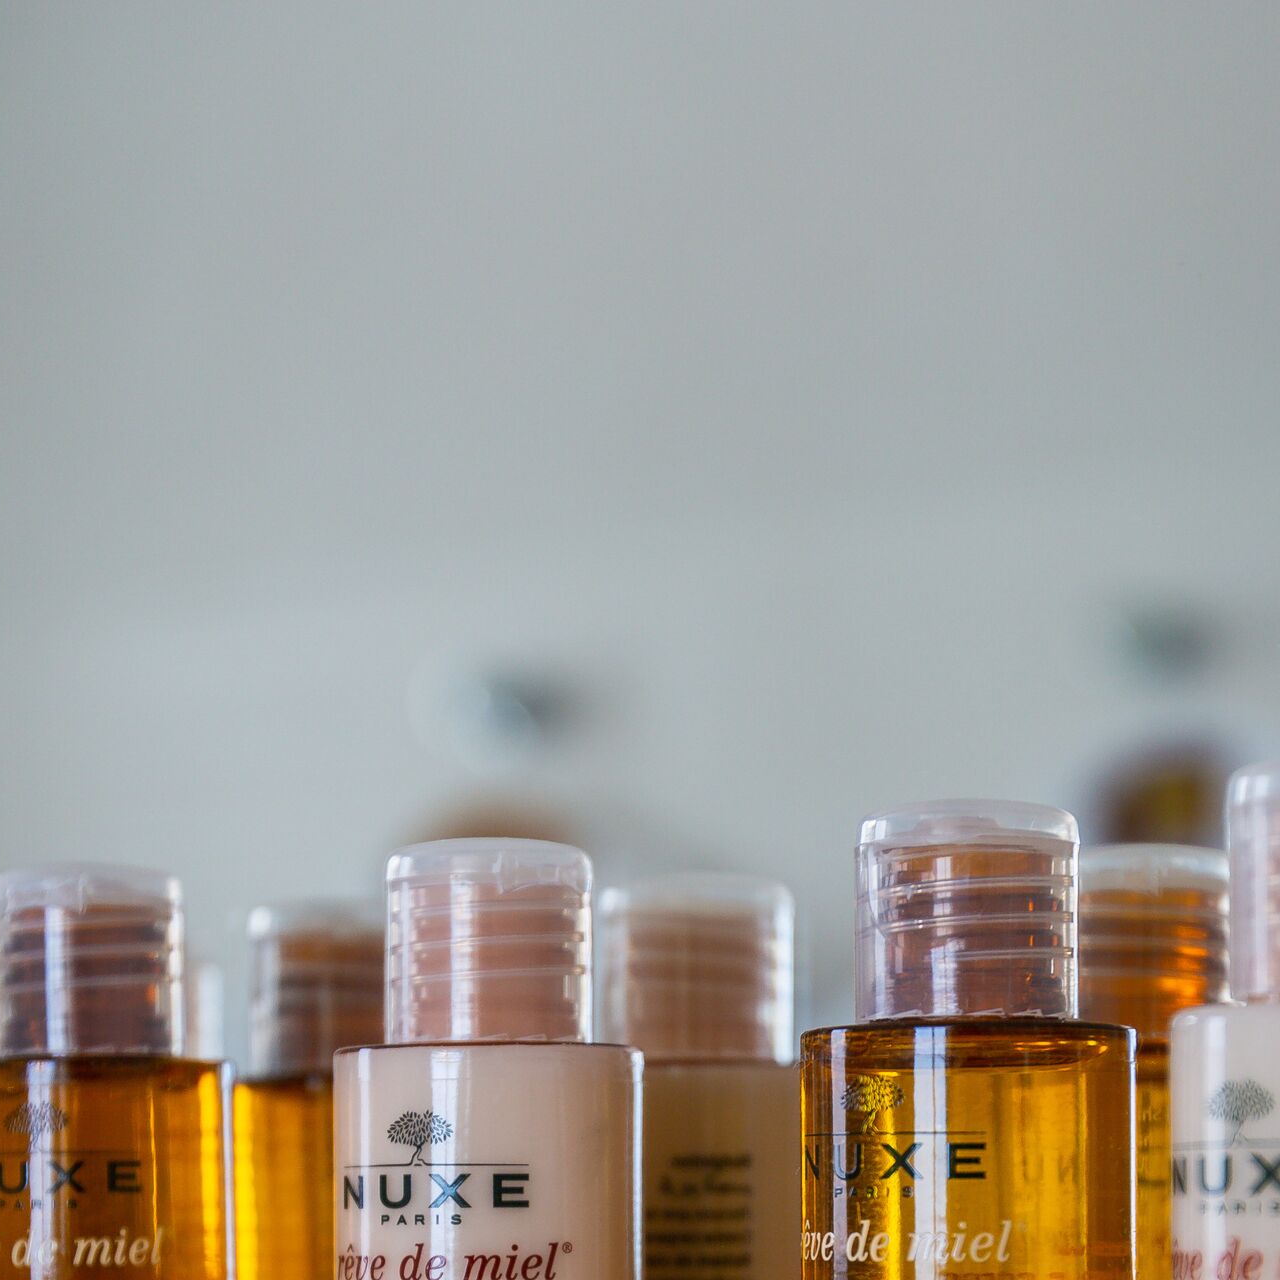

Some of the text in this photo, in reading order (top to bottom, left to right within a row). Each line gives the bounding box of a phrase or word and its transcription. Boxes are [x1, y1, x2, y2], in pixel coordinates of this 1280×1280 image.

[804, 1142, 987, 1180] NUXE
[343, 1173, 530, 1209] NUXE
[833, 1186, 914, 1198] PARIS
[380, 1213, 463, 1226] PARIS
[11, 1228, 57, 1268] de
[72, 1226, 162, 1268] miel
[801, 1219, 1013, 1264] êve de miel
